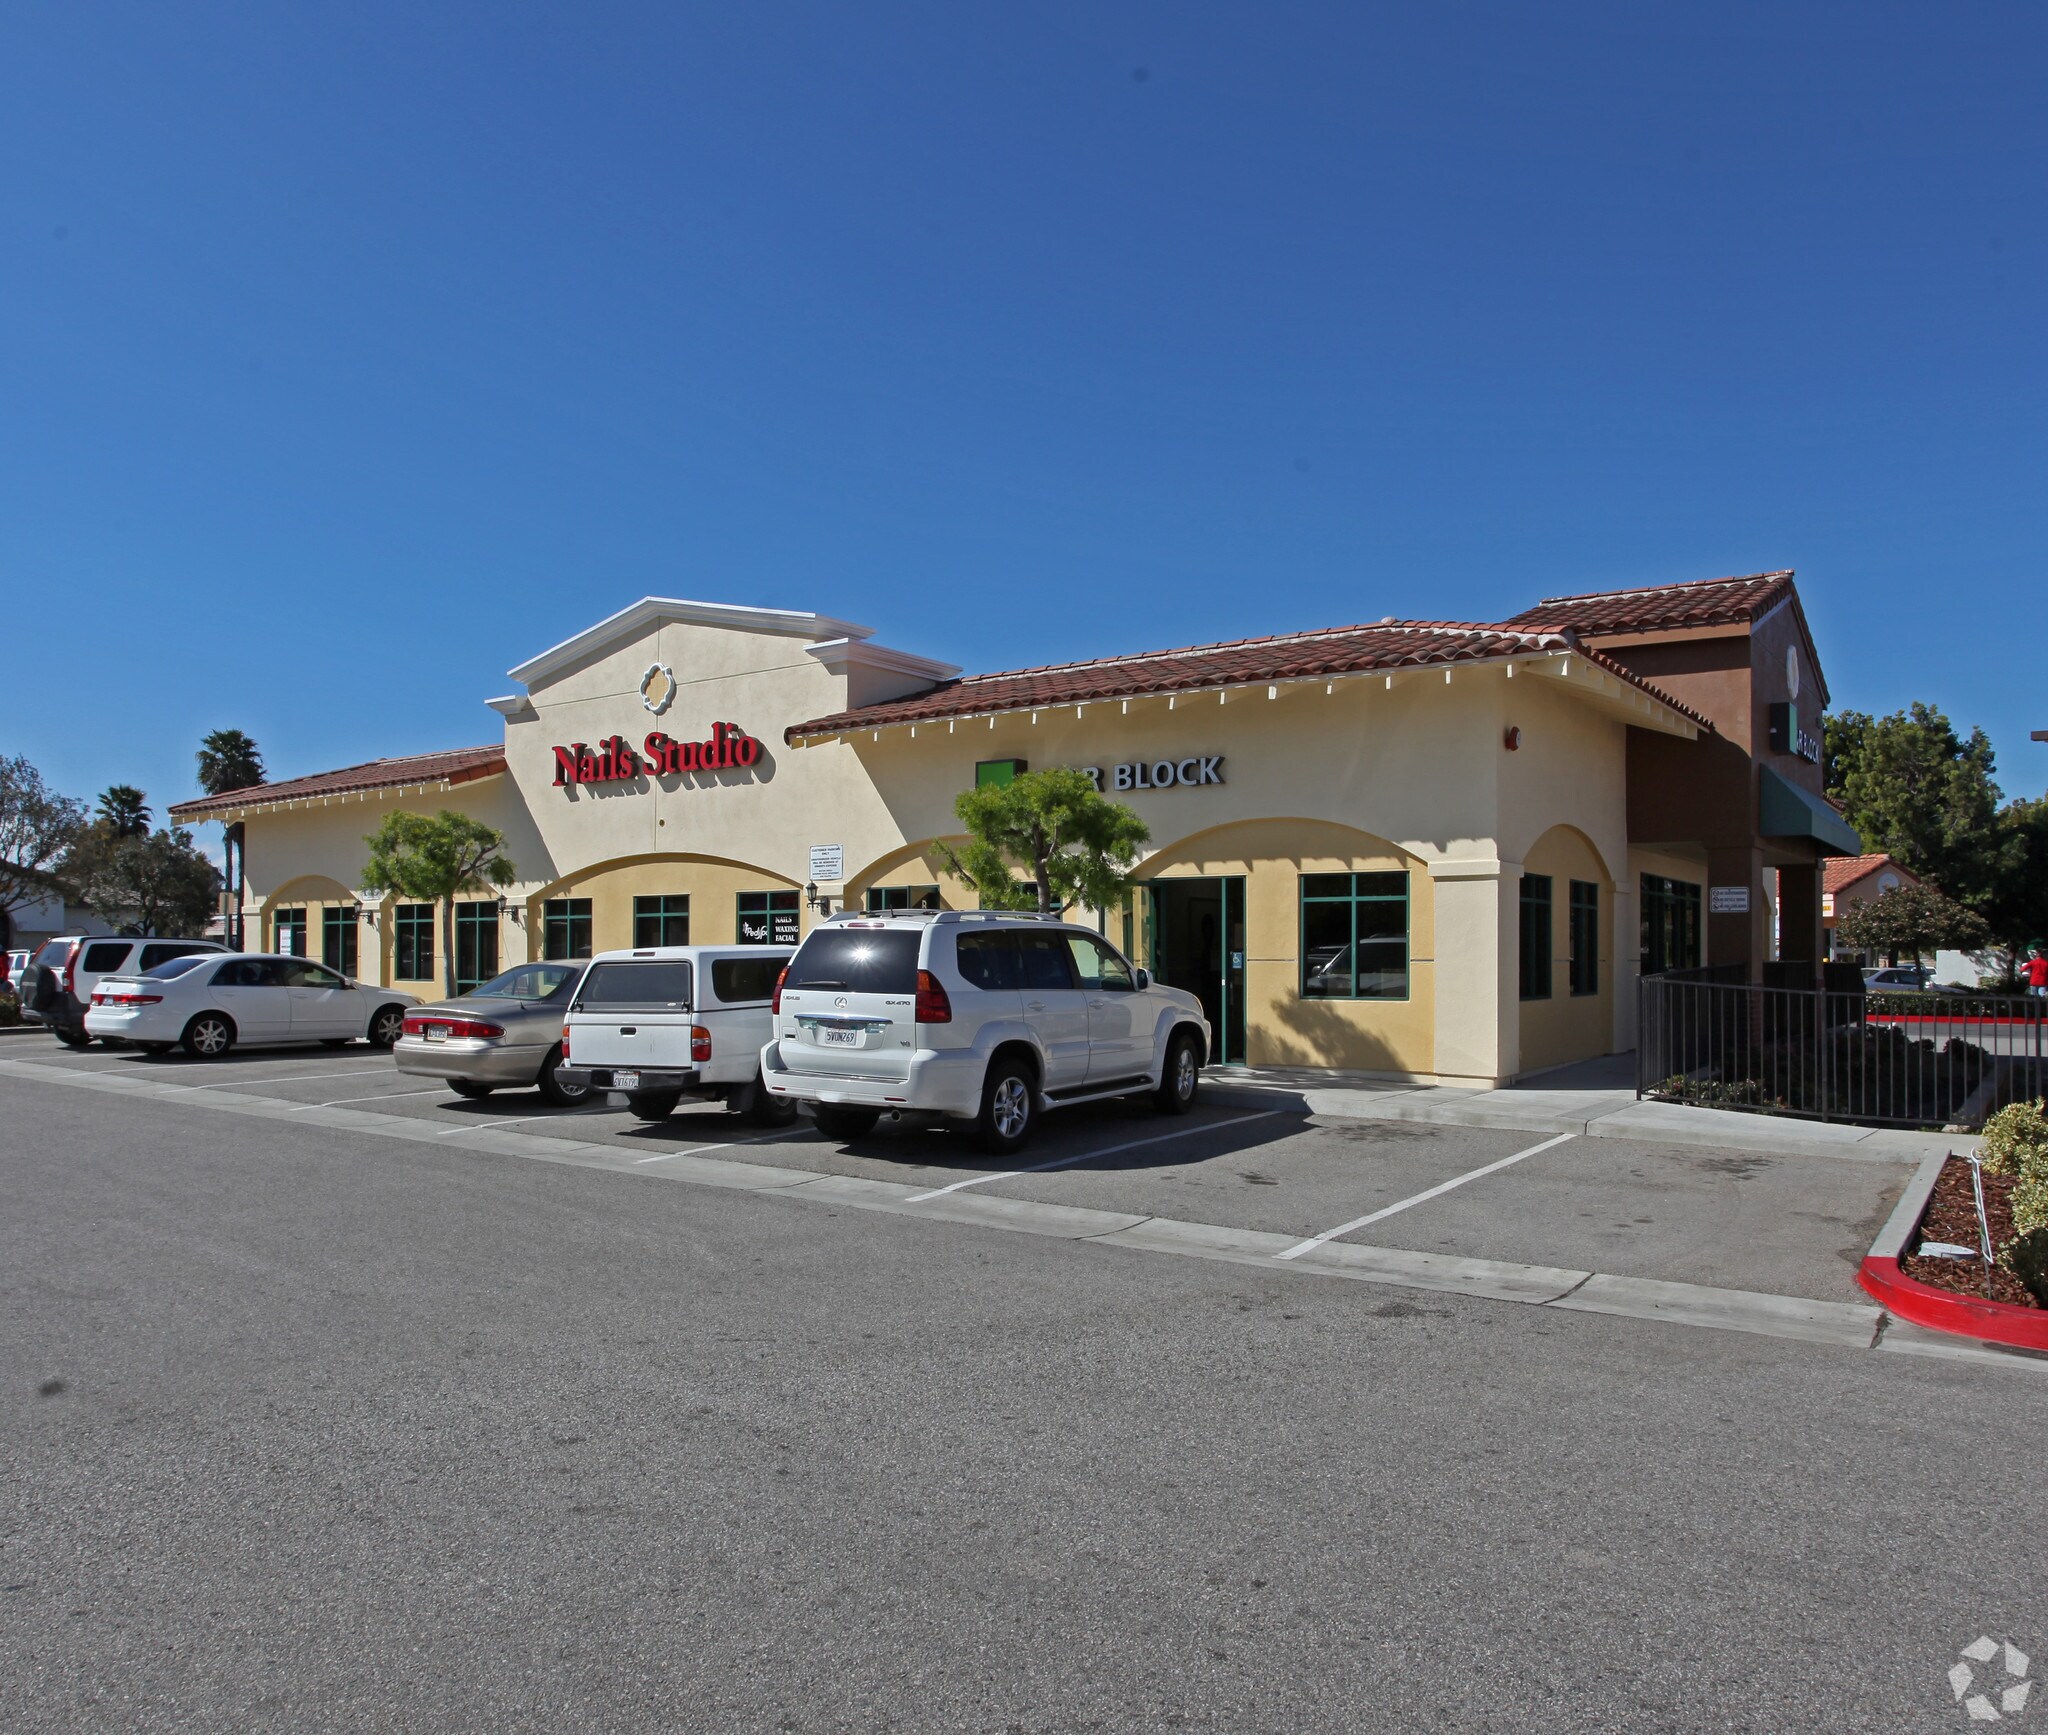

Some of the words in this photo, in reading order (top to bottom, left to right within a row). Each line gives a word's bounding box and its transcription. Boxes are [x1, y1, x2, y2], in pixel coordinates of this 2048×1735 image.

[552, 735, 635, 786] Nails
[643, 721, 760, 776] Studio
[1114, 756, 1222, 791] BLOCK
